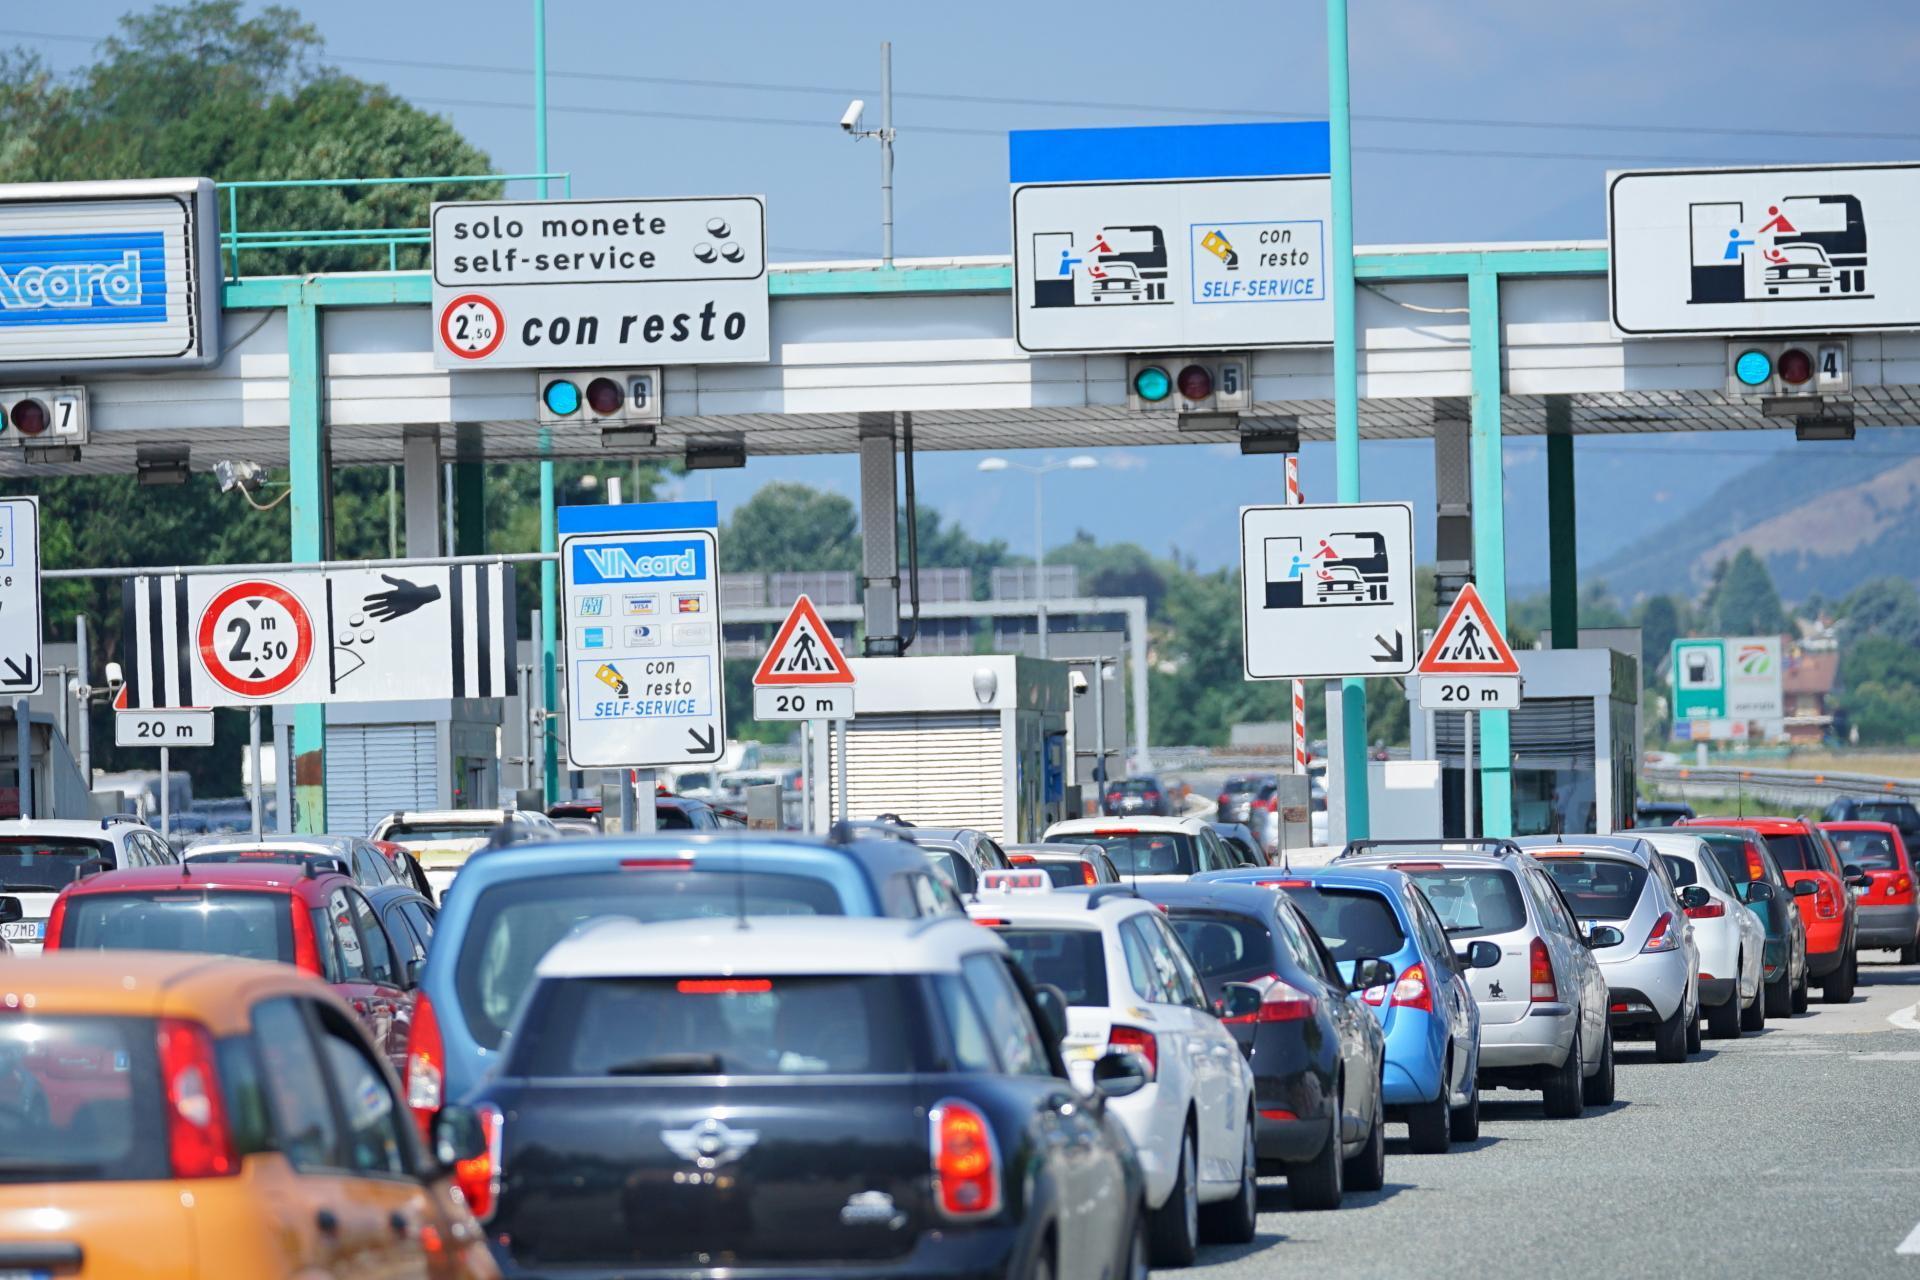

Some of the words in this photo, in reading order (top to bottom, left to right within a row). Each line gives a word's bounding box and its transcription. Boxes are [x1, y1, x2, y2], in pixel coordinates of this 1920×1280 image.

[454, 216, 524, 240] solo
[542, 212, 666, 238] monete
[1259, 229, 1291, 245] con
[454, 245, 656, 274] self-service
[1259, 248, 1309, 267] resto
[1202, 278, 1314, 298] SELF-SERVICE
[522, 316, 599, 347] con
[619, 301, 746, 344] resto
[1823, 352, 1837, 379] 4
[1223, 368, 1237, 395] 5
[633, 382, 646, 409] 6
[59, 402, 72, 428] 7
[645, 661, 675, 675] con
[645, 678, 692, 696] resto
[1441, 684, 1470, 701] 20
[1481, 690, 1499, 701] m
[594, 699, 696, 717] SELF-SERVICE
[776, 695, 805, 712] 20
[816, 699, 833, 711] m
[137, 721, 166, 738] 20
[176, 725, 193, 738] m
[0, 924, 36, 938] 57MB
